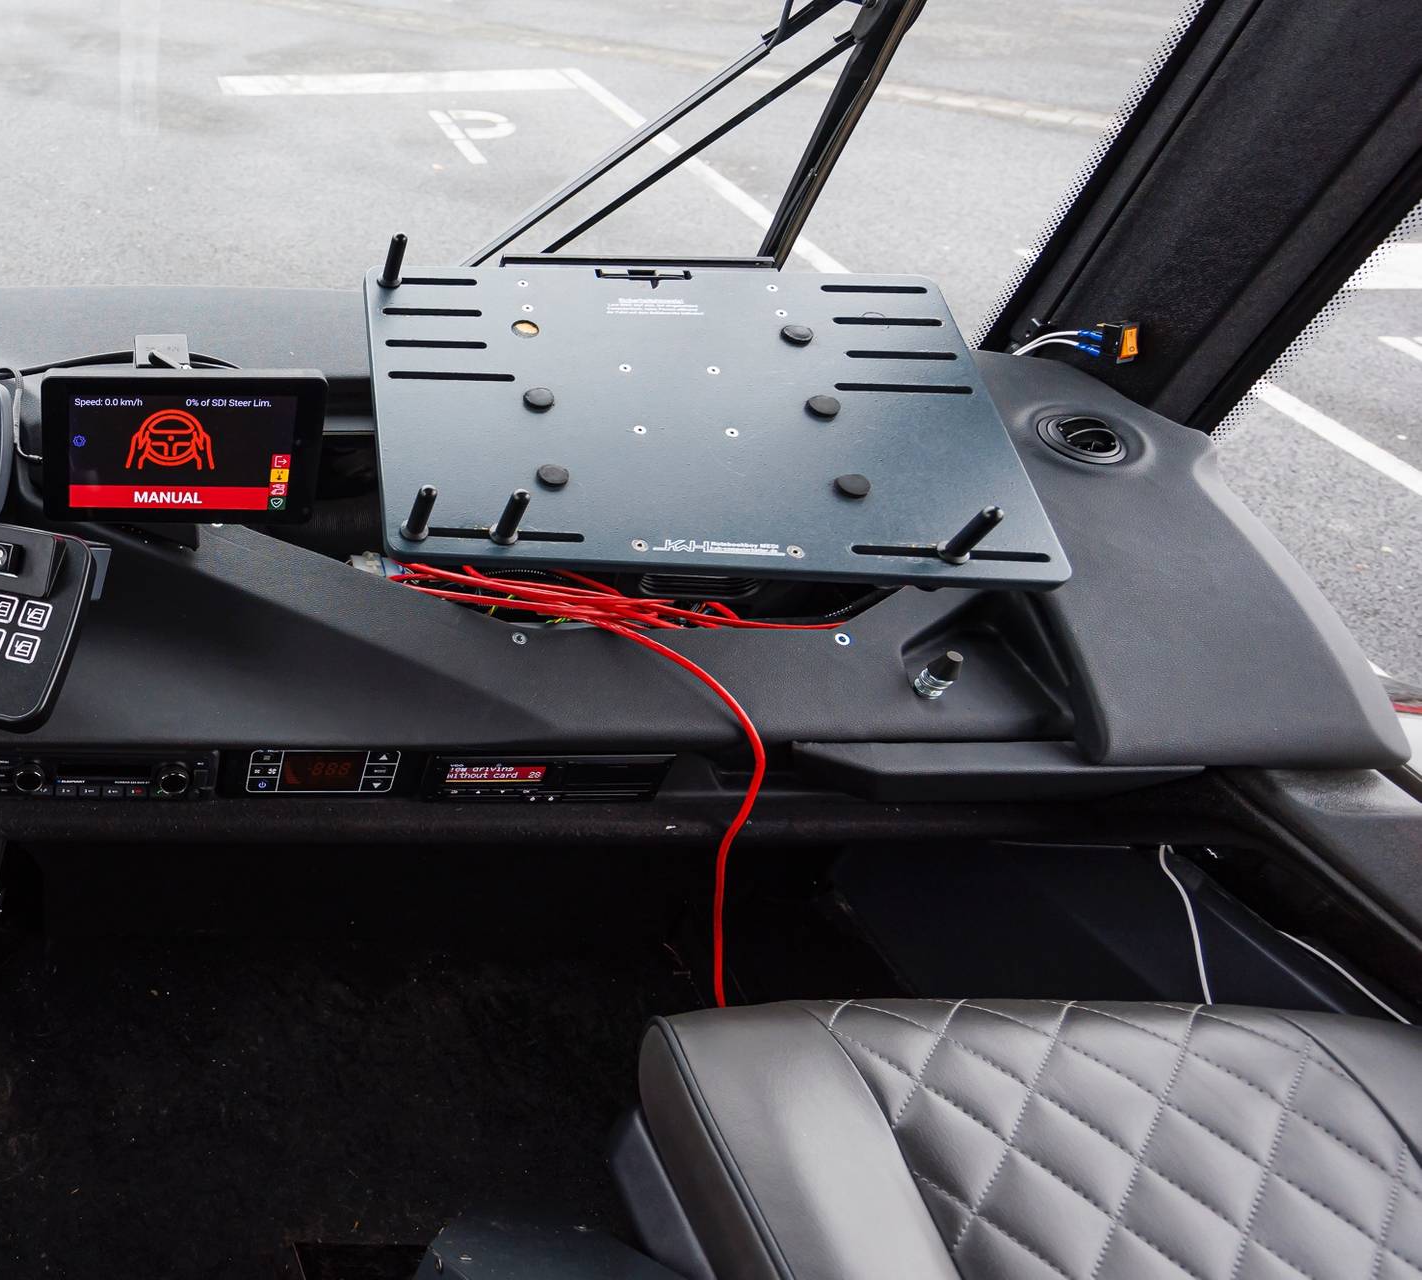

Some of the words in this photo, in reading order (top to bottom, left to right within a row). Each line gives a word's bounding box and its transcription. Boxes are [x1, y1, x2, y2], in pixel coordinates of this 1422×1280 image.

[428, 110, 516, 164] P
[74, 398, 103, 408] Speed:
[120, 398, 143, 407] km/h
[185, 399, 199, 407] 0%
[200, 399, 210, 407] of
[211, 399, 227, 407] SDI
[228, 399, 252, 407] Steer
[253, 399, 272, 407] Lim.
[133, 491, 203, 504] MANUAL
[446, 771, 488, 779] without
[492, 771, 519, 779] card
